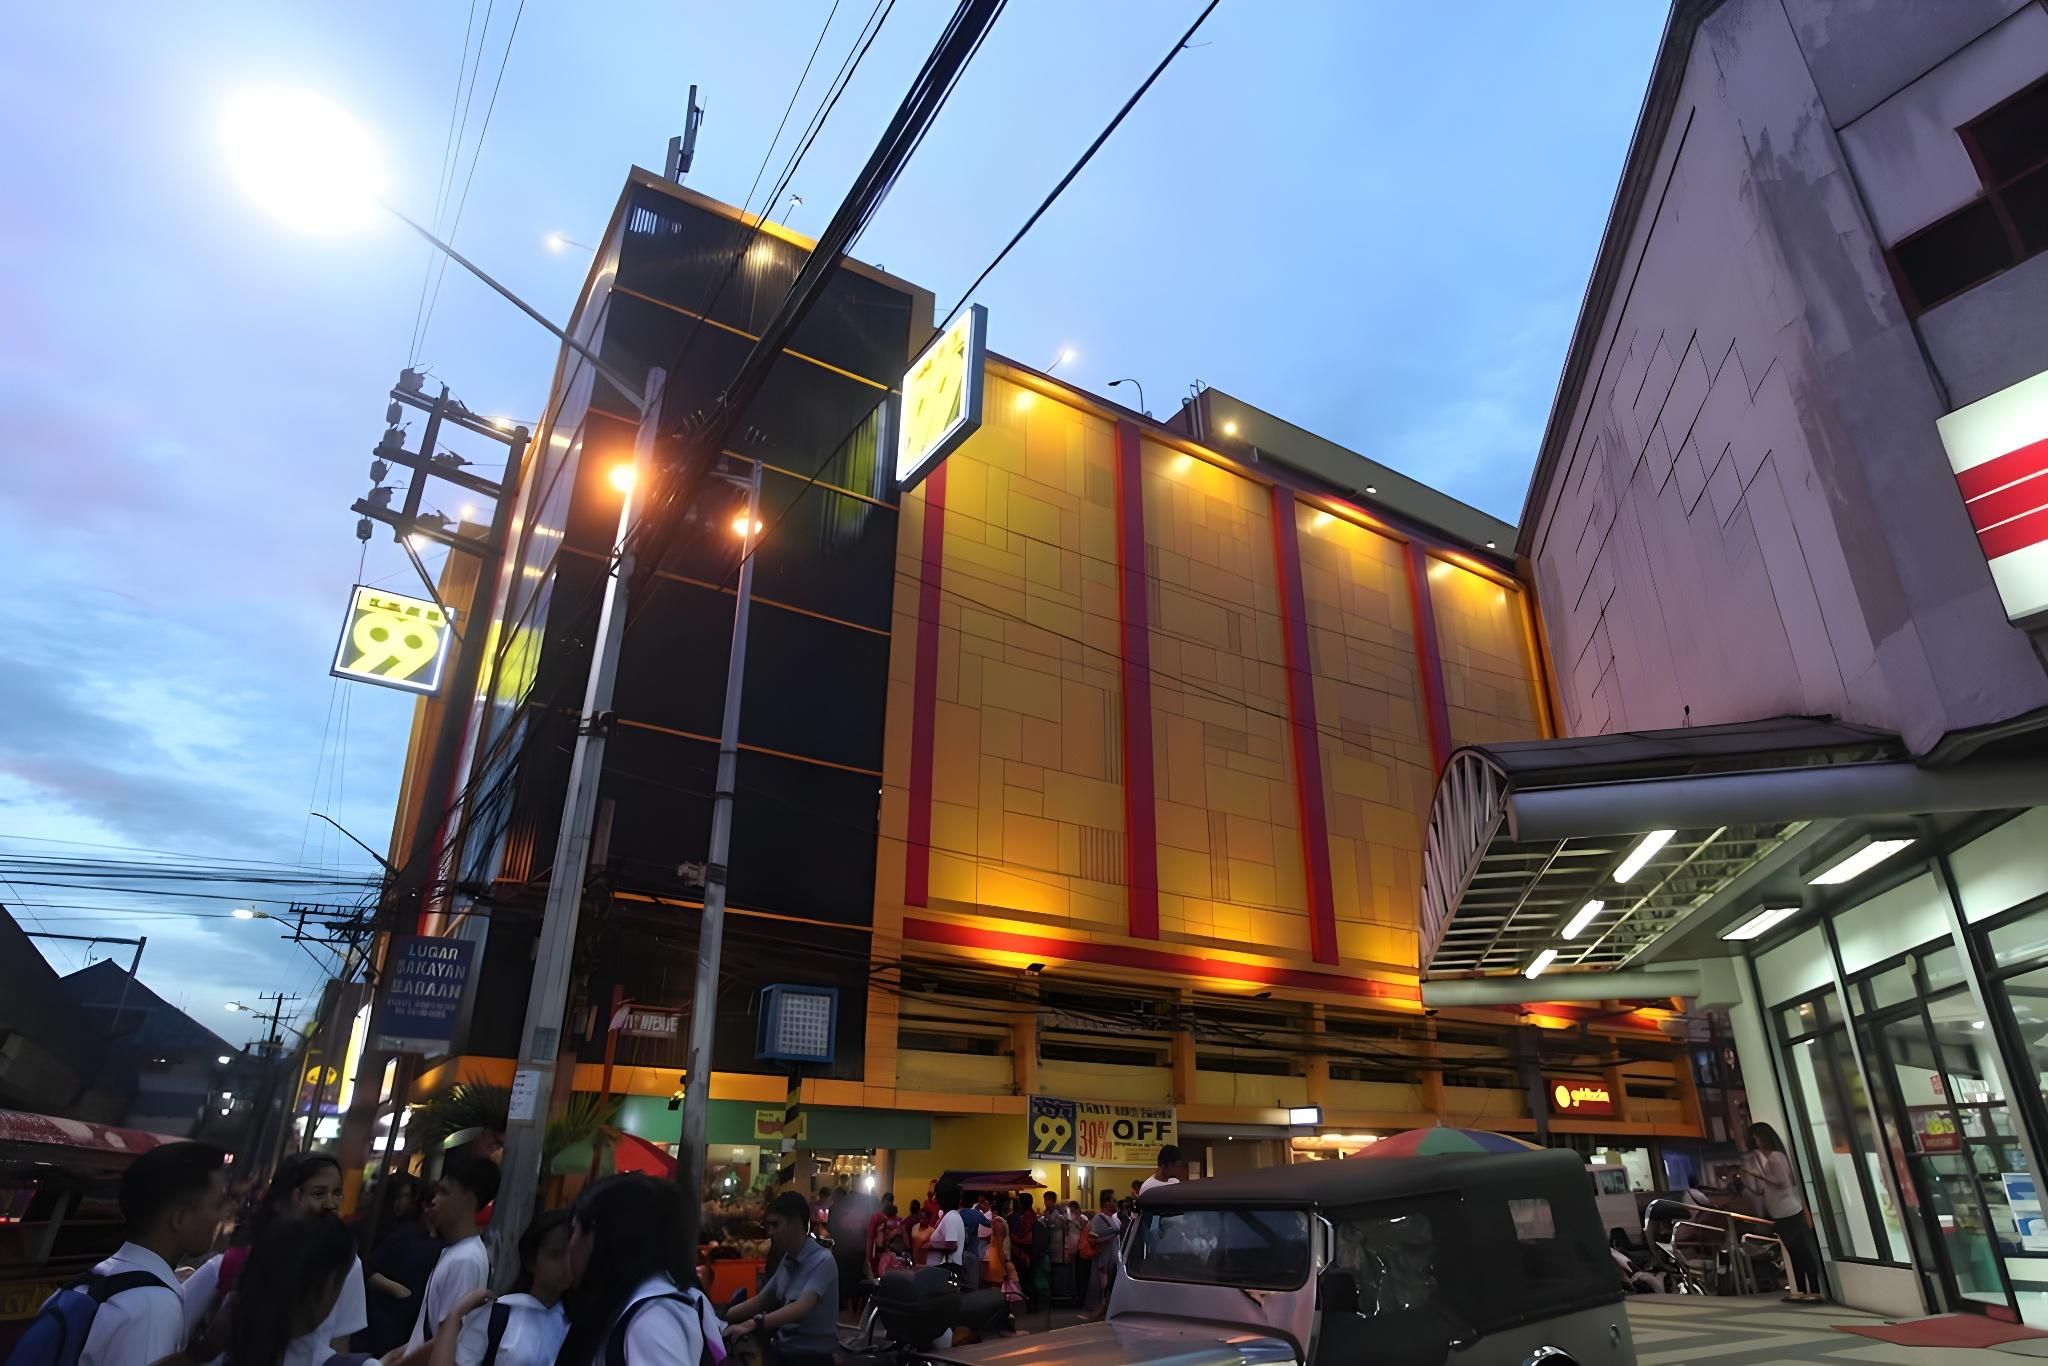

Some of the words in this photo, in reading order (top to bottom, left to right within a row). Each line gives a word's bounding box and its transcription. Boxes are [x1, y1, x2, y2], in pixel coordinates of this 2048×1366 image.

[349, 612, 439, 681] 99
[1033, 1116, 1072, 1153] 99
[1112, 1119, 1171, 1141] OFF
